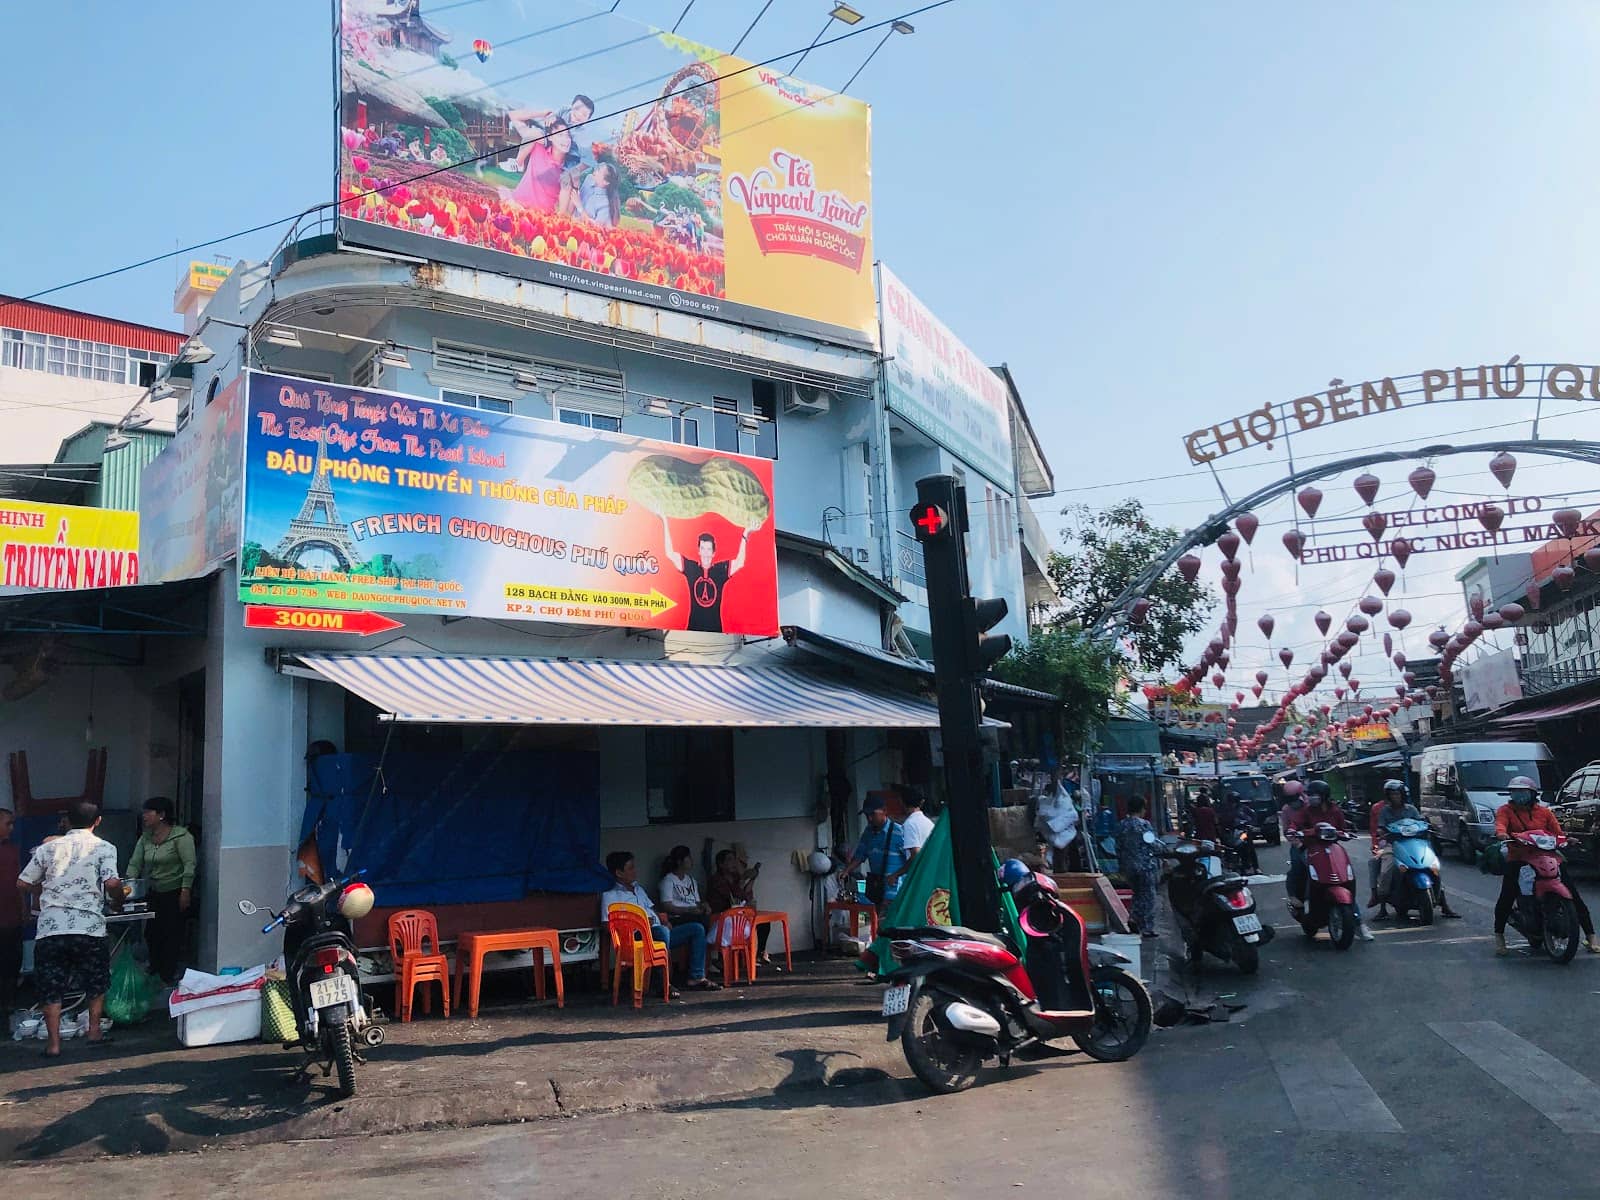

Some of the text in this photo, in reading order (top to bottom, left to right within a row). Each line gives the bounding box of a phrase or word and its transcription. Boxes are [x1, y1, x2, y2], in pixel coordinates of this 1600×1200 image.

[773, 151, 811, 187] Tết
[729, 170, 867, 228] Vinpearl Land
[549, 271, 662, 300] http://tet.vinpearlland.com
[682, 299, 700, 308] 1900
[1186, 401, 1277, 463] CHỢ
[1294, 377, 1402, 432] ĐÊM
[1422, 354, 1525, 403] PHÚ
[257, 411, 285, 437] The
[287, 416, 323, 442] Best
[361, 428, 402, 454] From
[401, 434, 427, 458] The
[266, 448, 628, 516] ĐẬU PHỘNG TRUYỀN THỐNG CỦA PHÁP
[351, 512, 659, 576] FRENCH CHOUCHOUS PHÚ QUỐC
[1357, 537, 1426, 559] QUC
[1436, 528, 1510, 551] NIGHT
[84, 548, 124, 588] NAM
[351, 574, 376, 586] FREE
[377, 577, 400, 588] SHIP
[506, 587, 525, 597] 128
[528, 589, 557, 601] BẠCH
[610, 596, 632, 607] 300M,
[506, 603, 535, 614] KP.2,
[539, 606, 563, 616] CHỢ
[567, 607, 591, 618] ĐÊM
[594, 609, 616, 619] PHÚ
[275, 610, 343, 629] 300M
